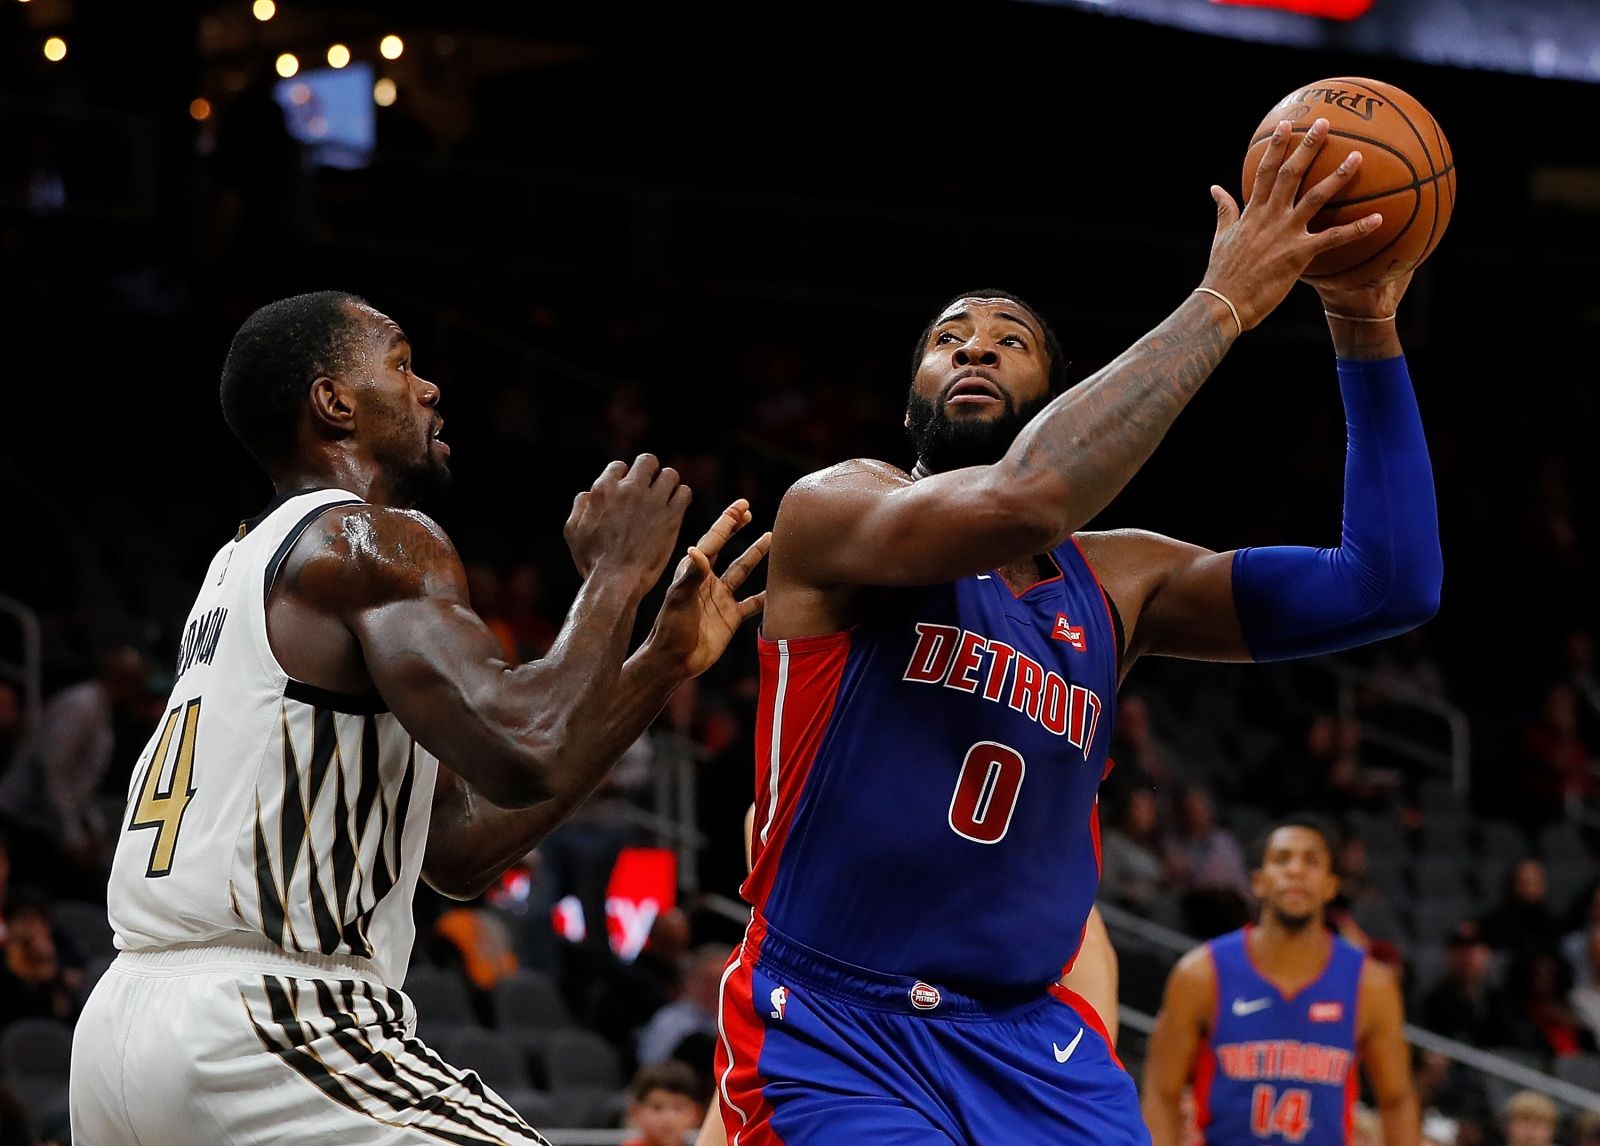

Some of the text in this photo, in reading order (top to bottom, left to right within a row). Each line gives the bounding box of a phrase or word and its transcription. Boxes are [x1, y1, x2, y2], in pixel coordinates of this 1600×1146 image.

[902, 622, 1102, 762] DETROIT
[948, 740, 1026, 845] 0
[1251, 1083, 1314, 1143] 14
